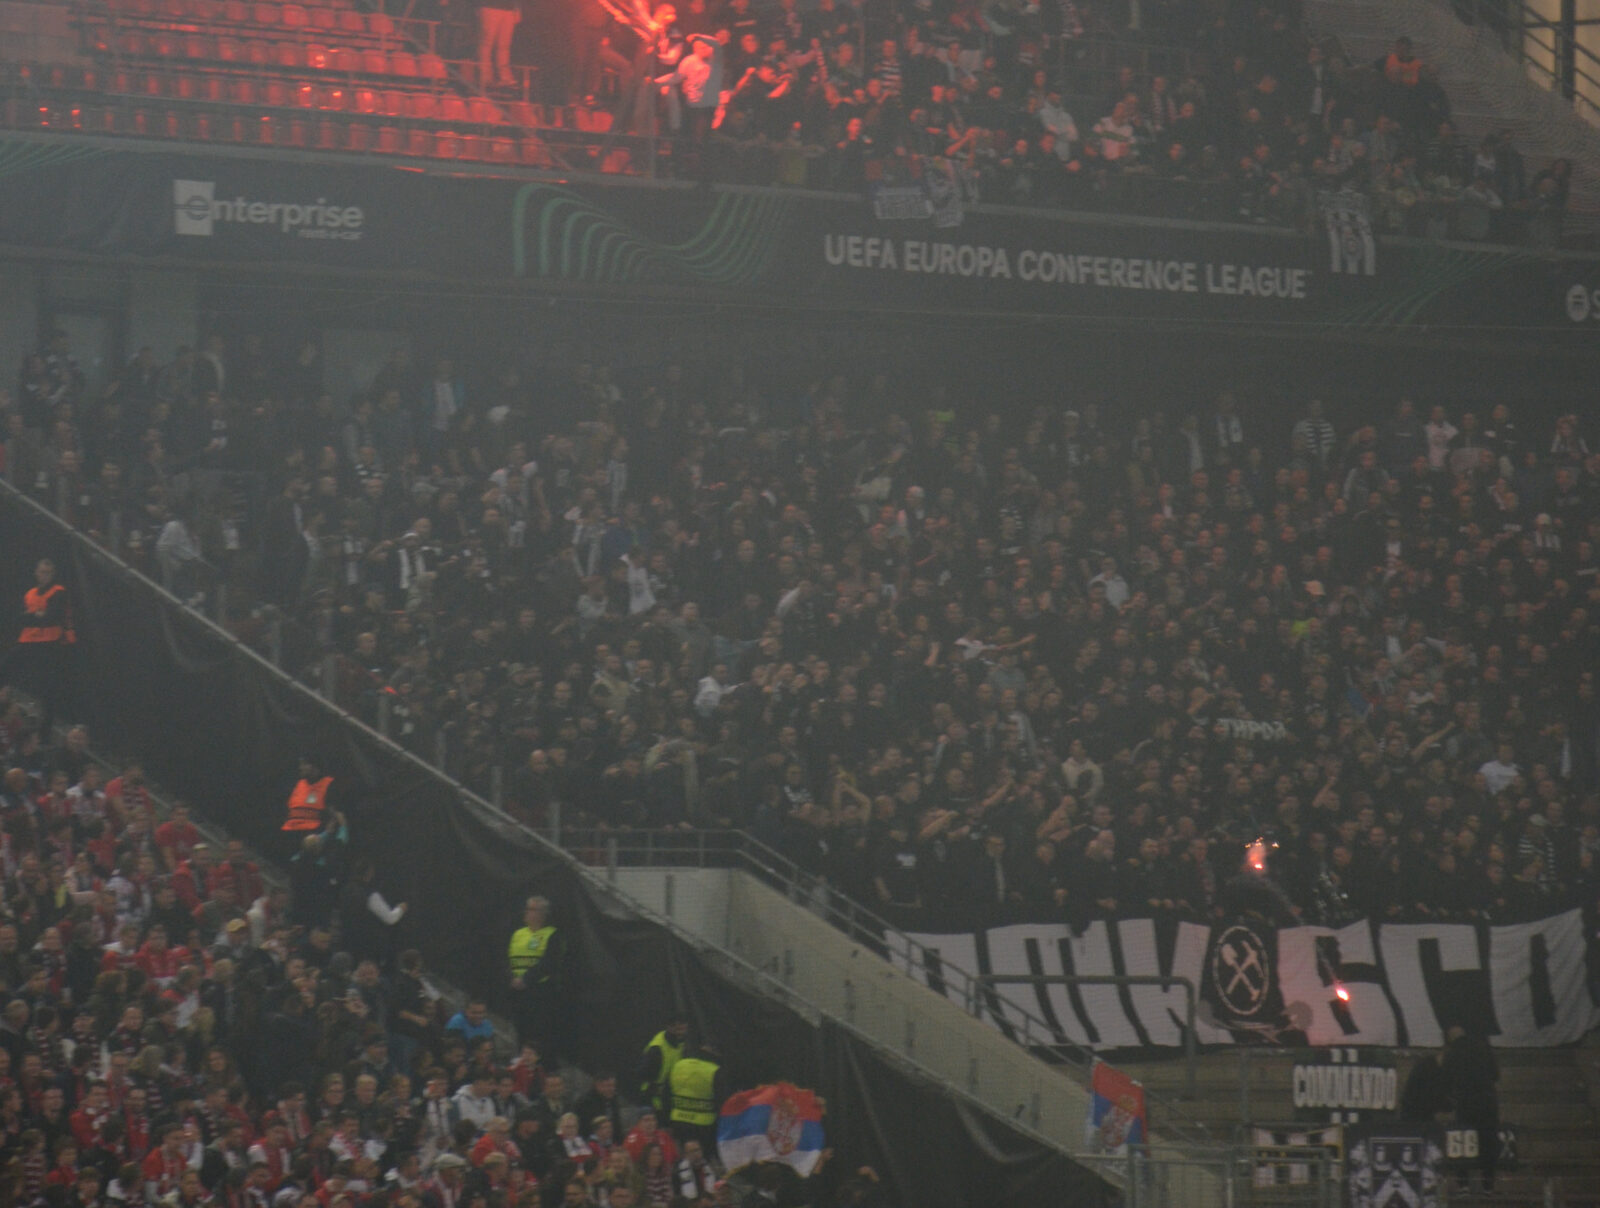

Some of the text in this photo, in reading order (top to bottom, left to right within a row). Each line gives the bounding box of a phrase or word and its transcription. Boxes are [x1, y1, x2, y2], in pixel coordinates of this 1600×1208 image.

[184, 194, 365, 233] enterprise
[825, 234, 1306, 299] UEFA EUROPA CONFERENCE LEAGUE
